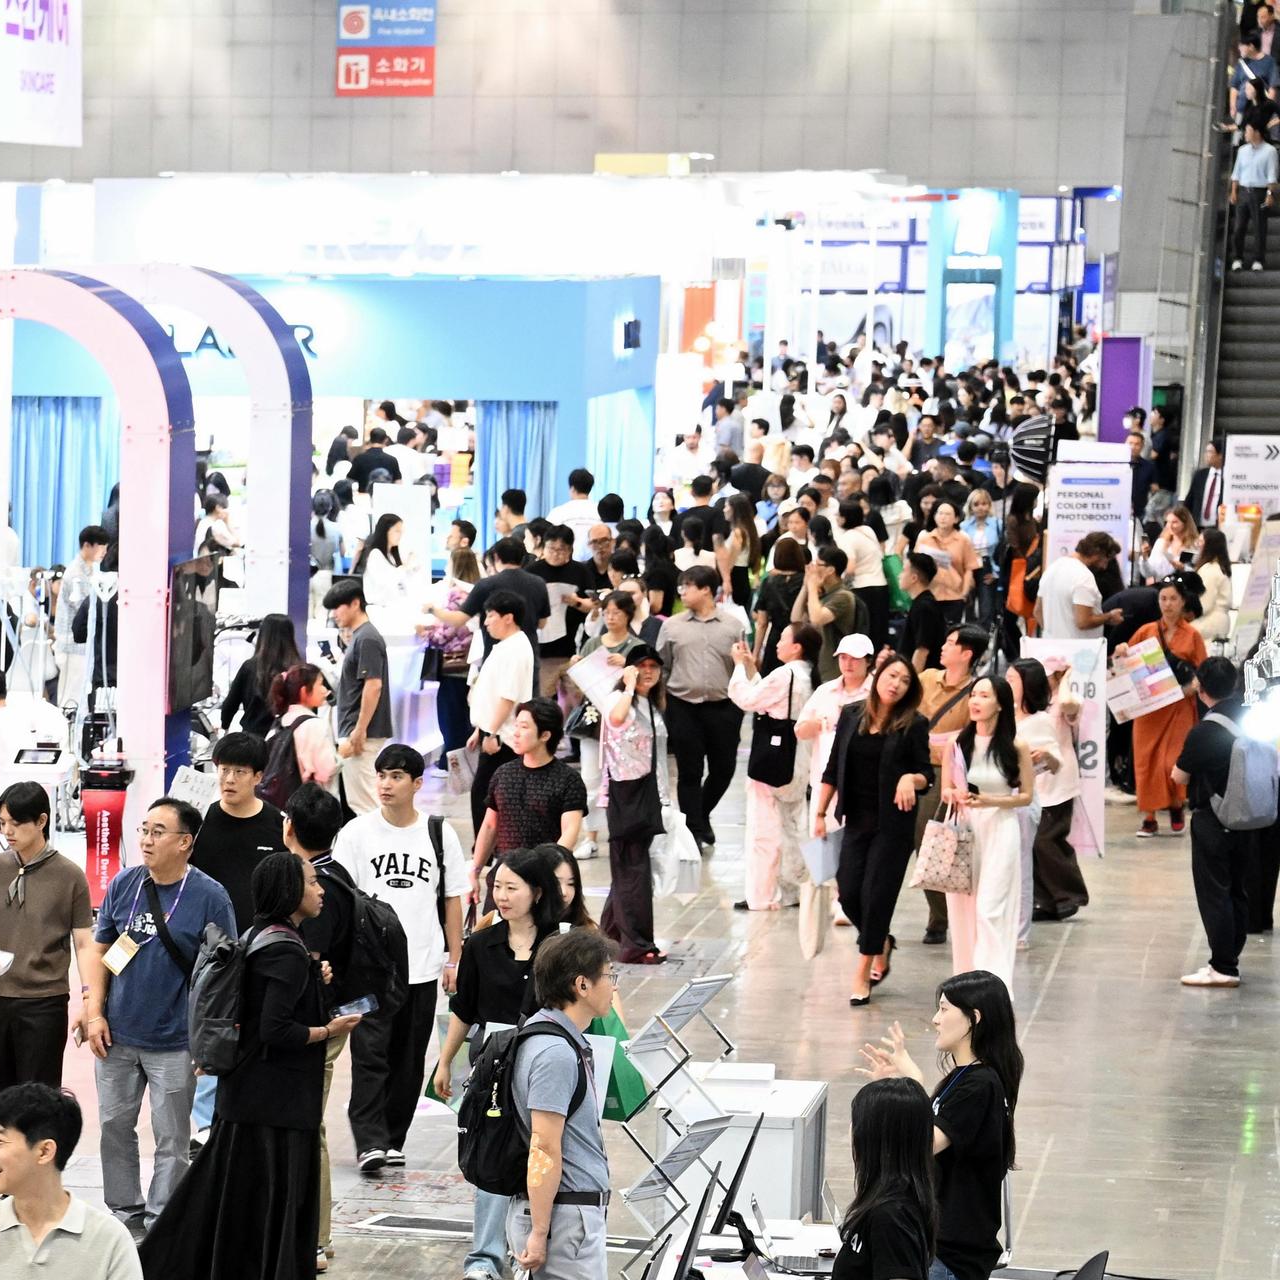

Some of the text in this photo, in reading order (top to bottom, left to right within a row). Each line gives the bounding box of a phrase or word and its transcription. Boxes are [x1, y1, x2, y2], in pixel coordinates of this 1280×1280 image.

[1057, 491, 1104, 499] PERSONAL
[1091, 502, 1112, 510] TEST
[100, 809, 111, 890] Aesthetic Device
[370, 853, 431, 883] YALE
